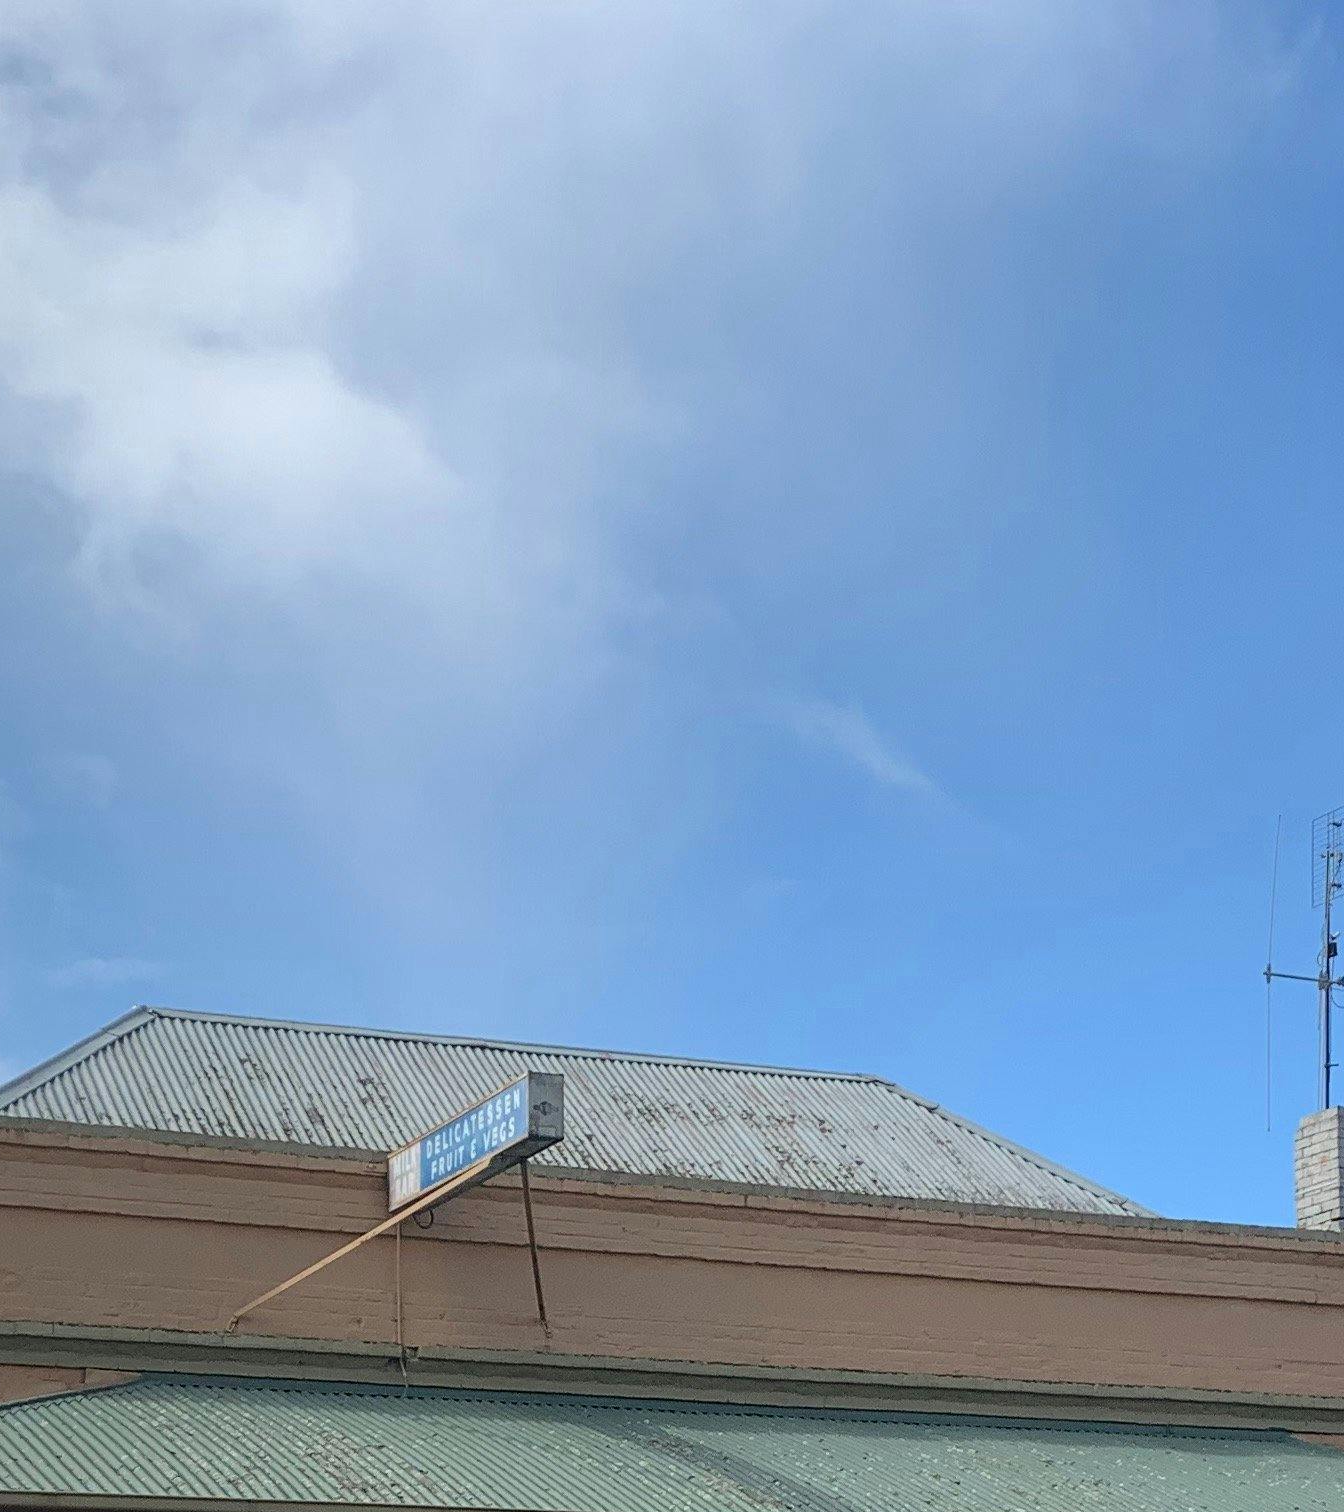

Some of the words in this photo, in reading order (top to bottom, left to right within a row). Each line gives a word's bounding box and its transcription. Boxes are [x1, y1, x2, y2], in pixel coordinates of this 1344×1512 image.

[426, 1087, 521, 1160] DELICATESSEN
[430, 1144, 465, 1181] FRUIT
[483, 1116, 516, 1152] VEGS
